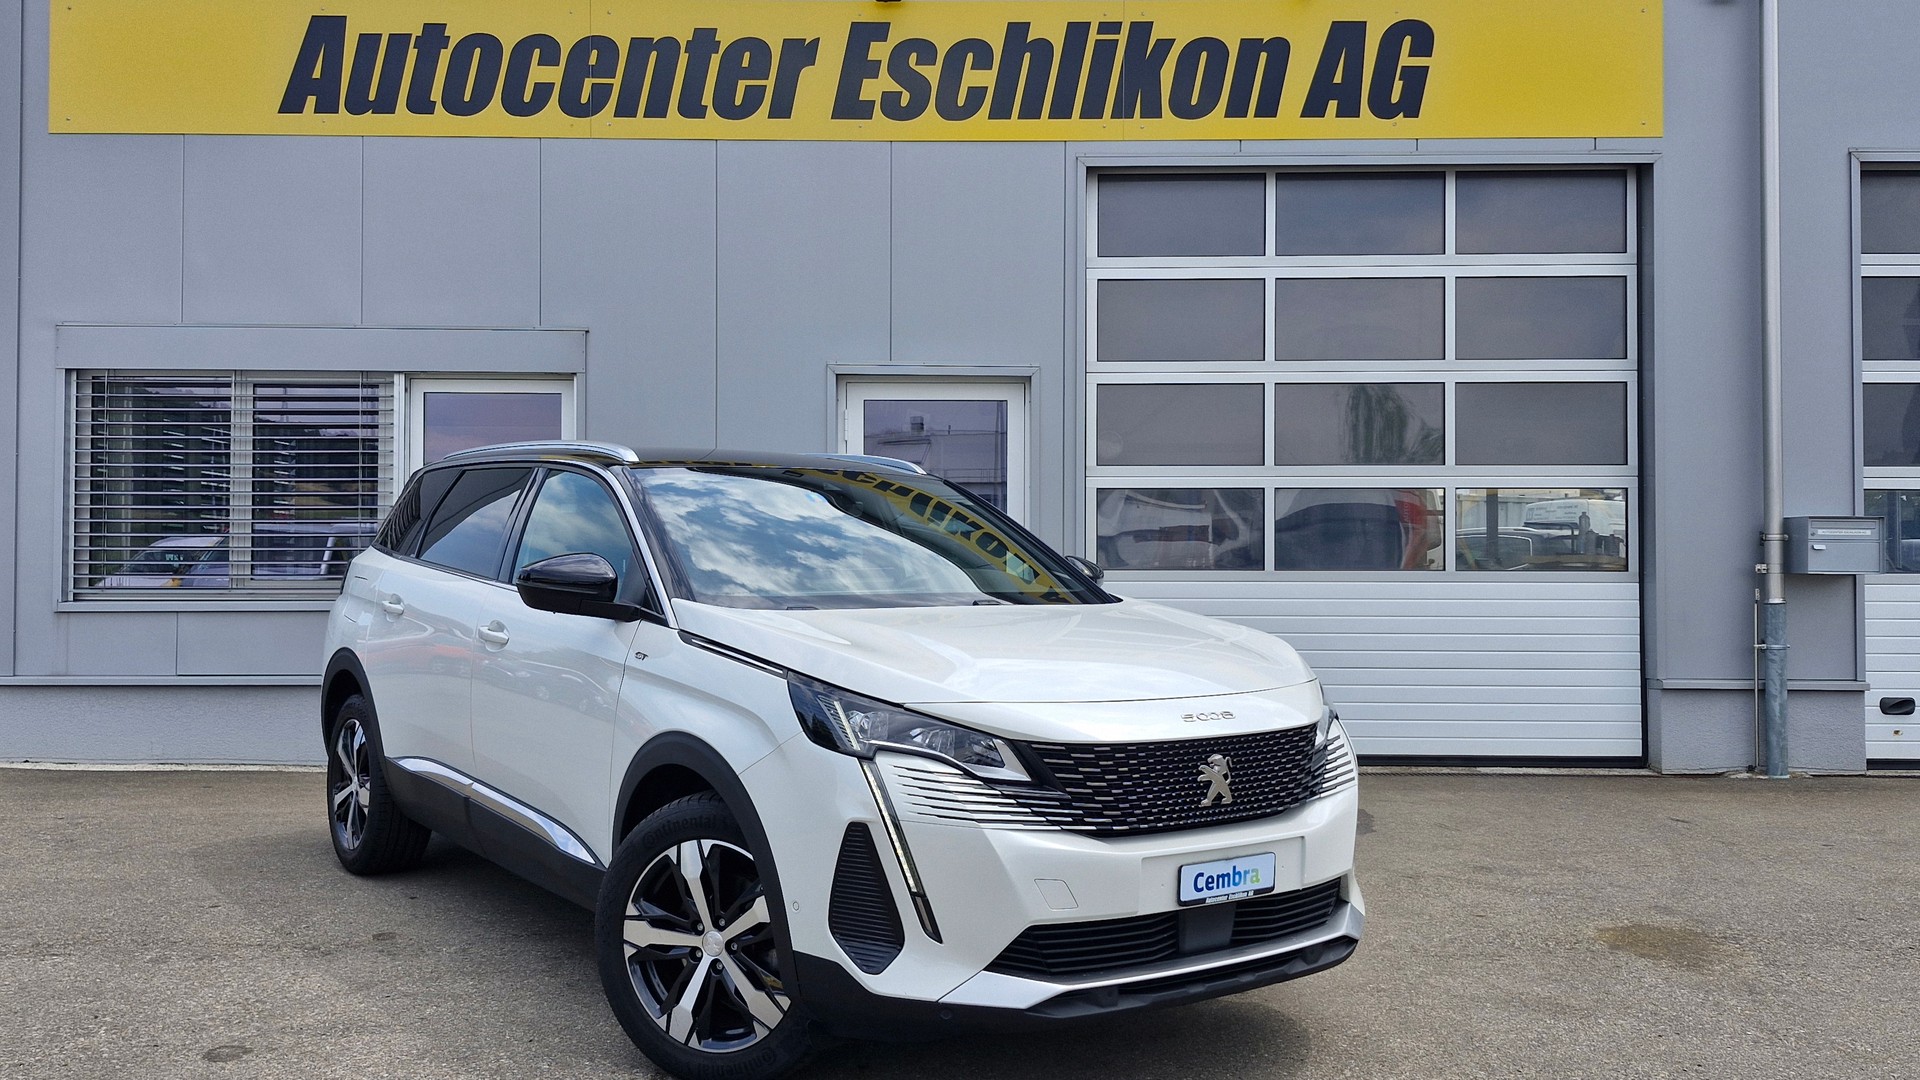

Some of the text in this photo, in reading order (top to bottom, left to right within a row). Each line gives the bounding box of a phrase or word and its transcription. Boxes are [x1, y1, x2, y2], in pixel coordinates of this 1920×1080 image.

[277, 15, 1435, 122] Autocenter Eschlikon AG
[635, 651, 649, 661] GT
[1181, 711, 1236, 722] 5008
[642, 814, 717, 848] Continental
[1193, 865, 1261, 893] Cembra
